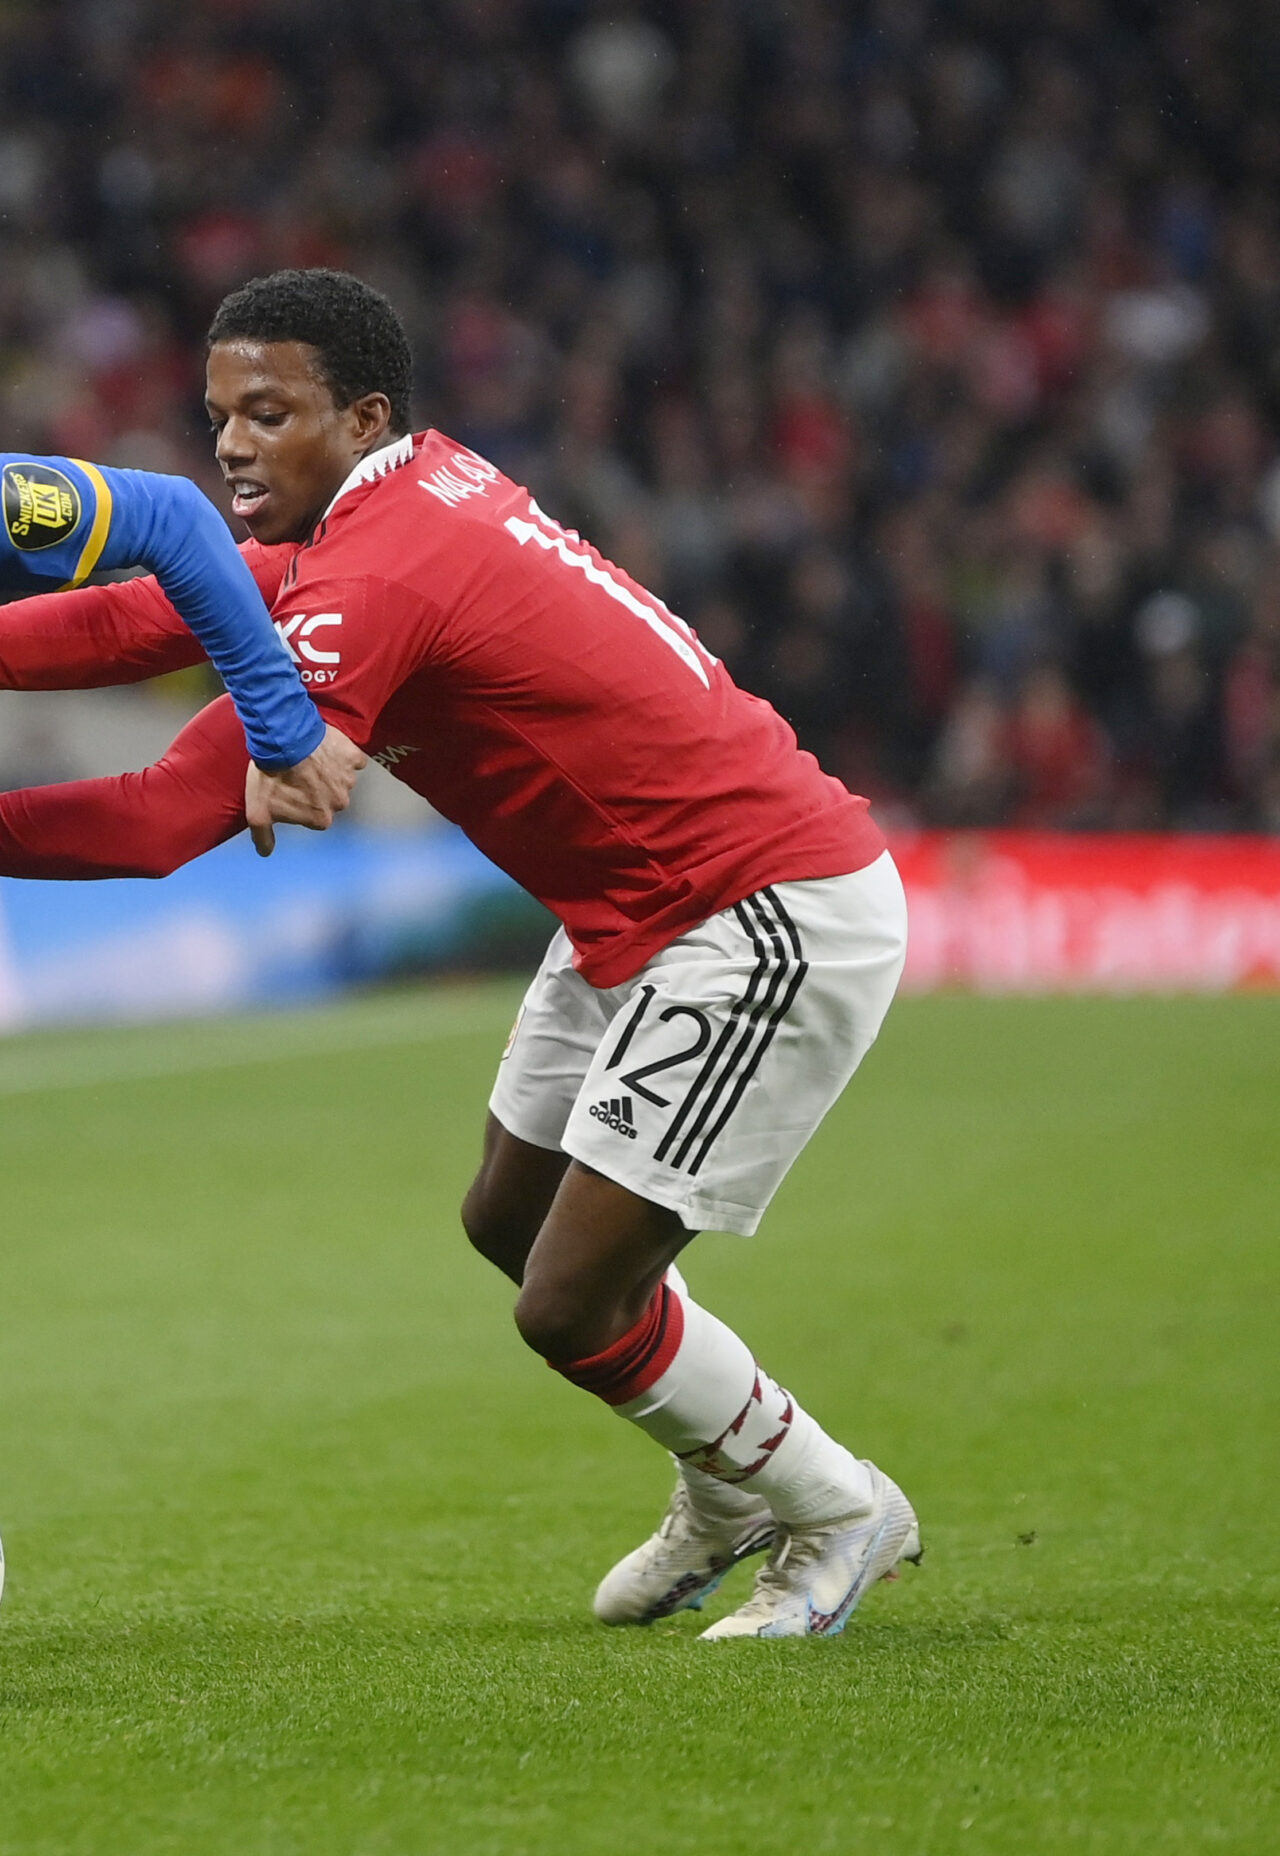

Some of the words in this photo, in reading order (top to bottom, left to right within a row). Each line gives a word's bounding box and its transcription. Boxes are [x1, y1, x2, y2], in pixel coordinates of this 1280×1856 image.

[9, 471, 34, 536] SNICKERS
[33, 489, 58, 523] UK
[59, 491, 73, 522] .COM
[604, 984, 712, 1109] 12
[588, 1104, 639, 1140] adidas
